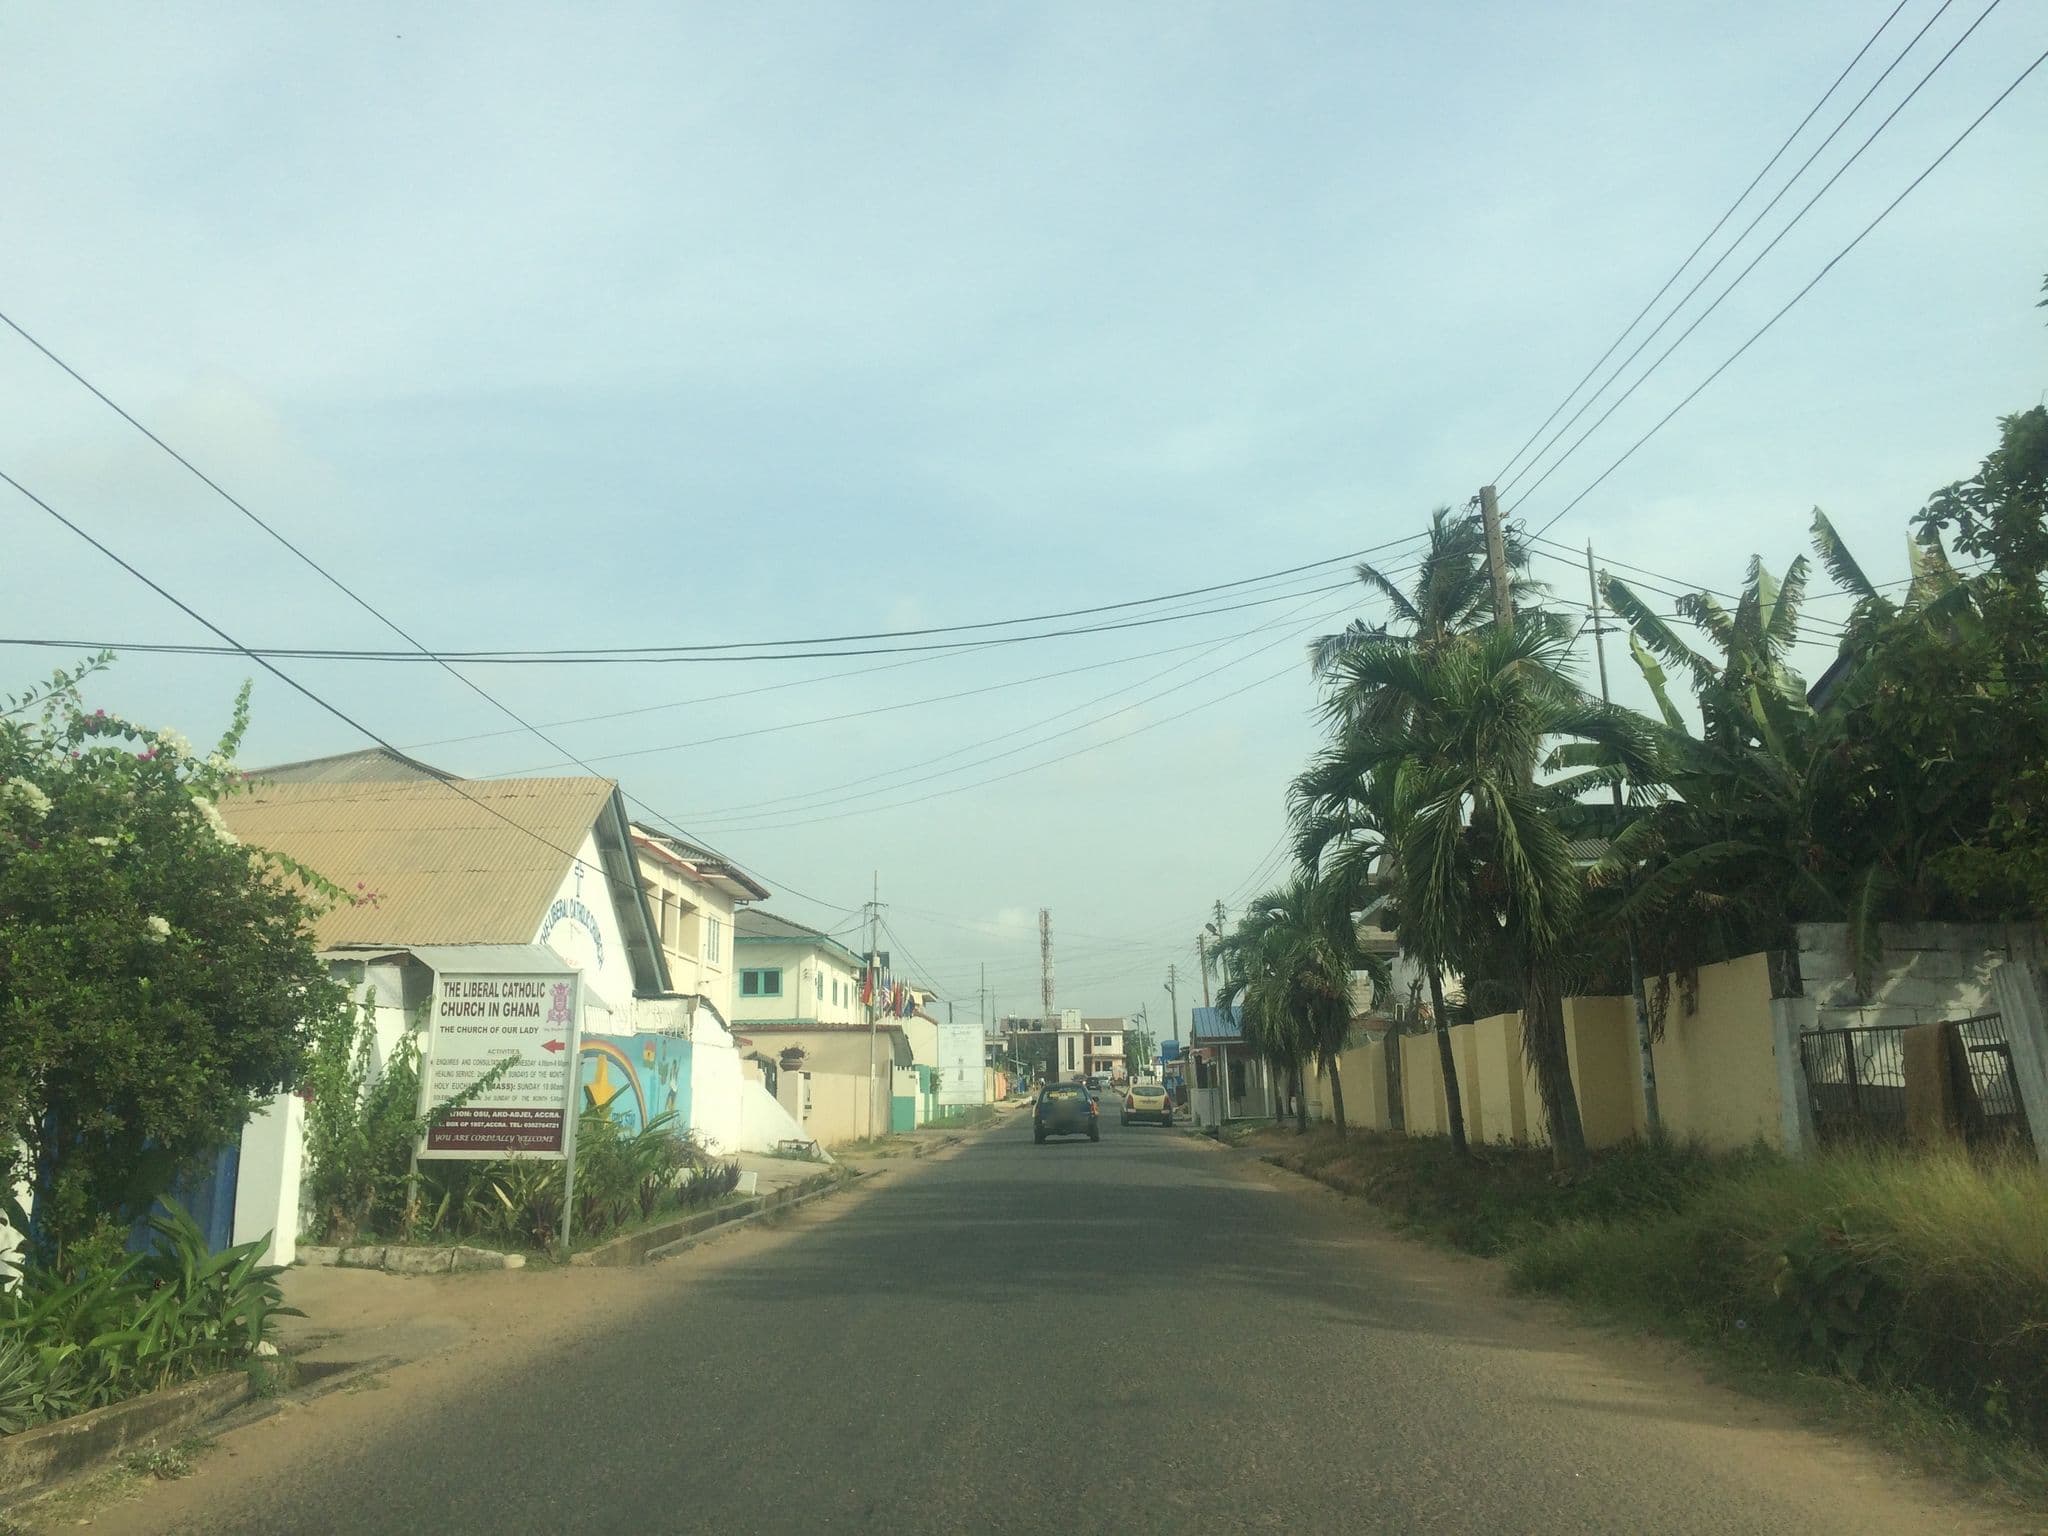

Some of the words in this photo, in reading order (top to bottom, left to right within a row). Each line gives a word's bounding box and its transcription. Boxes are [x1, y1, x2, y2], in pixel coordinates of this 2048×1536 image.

[443, 982, 461, 997] THE
[463, 982, 499, 998] LIBERAL
[501, 982, 546, 998] CATHOLIC
[440, 1002, 485, 1017] CHURCH
[488, 1002, 500, 1017] IN
[503, 1002, 540, 1017] GHANA
[440, 1026, 455, 1034] THE
[456, 1026, 488, 1034] CHURCH
[490, 1026, 501, 1034] OF
[502, 1026, 518, 1034] OUR
[519, 1026, 539, 1034] LADY
[461, 1058, 471, 1066] AND
[434, 1082, 450, 1090] HOLY
[473, 1111, 490, 1119] OSU,
[534, 1111, 561, 1119] ACCRA.
[435, 1134, 452, 1143] YOU
[452, 1134, 469, 1143] ARE
[470, 1134, 515, 1144] CORDIALLY
[516, 1134, 554, 1144] WELCOME
